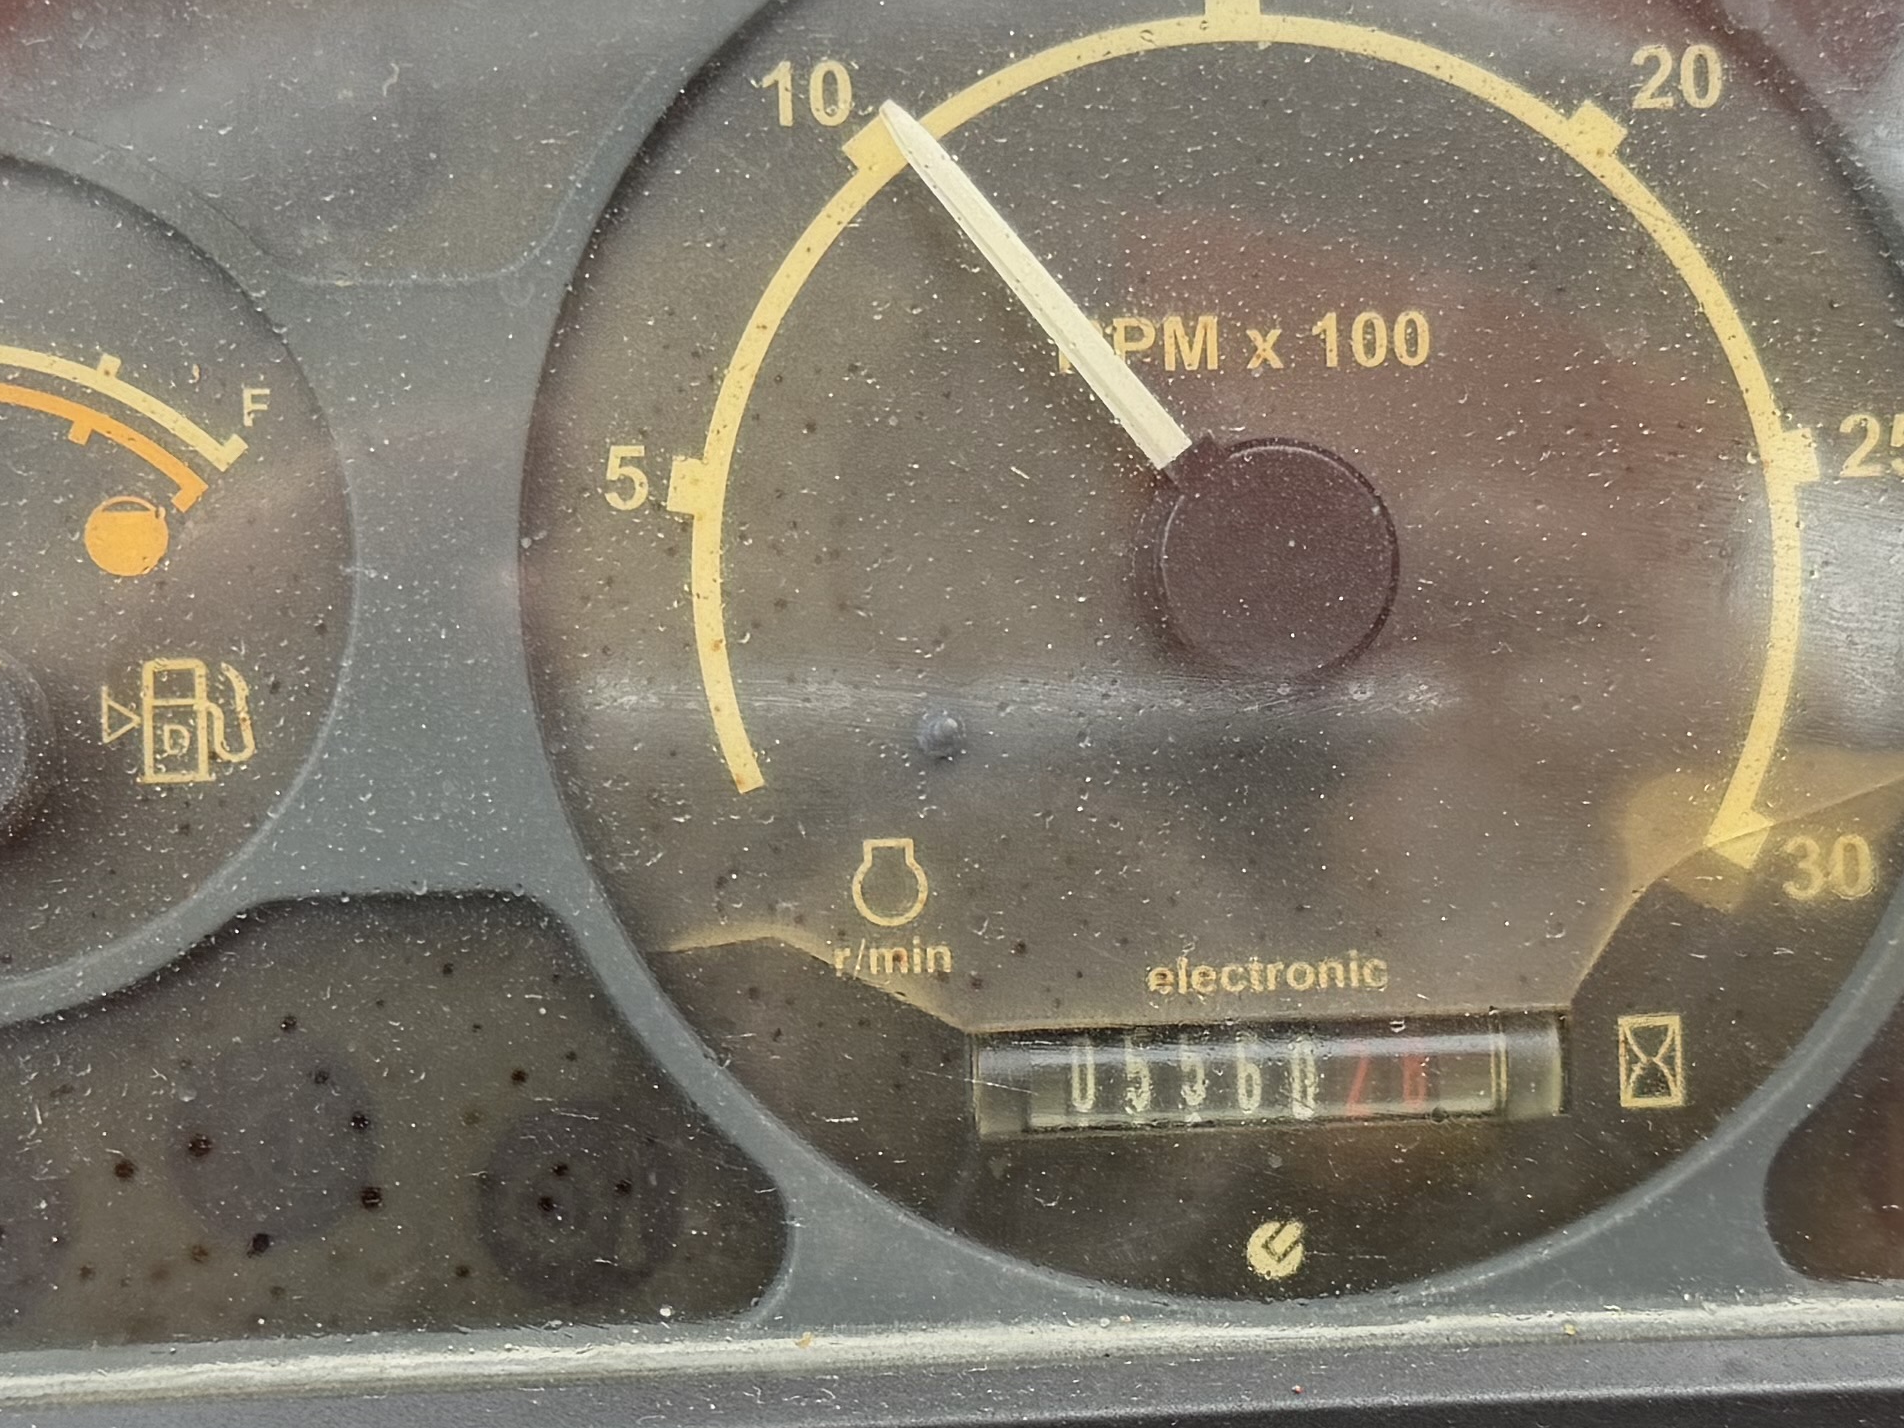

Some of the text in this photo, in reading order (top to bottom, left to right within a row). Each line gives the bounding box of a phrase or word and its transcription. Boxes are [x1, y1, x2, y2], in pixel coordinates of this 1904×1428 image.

[761, 59, 853, 127] 10
[1630, 44, 1724, 110] 20
[1246, 328, 1284, 369] x
[1312, 311, 1431, 369] 100
[241, 386, 271, 427] F
[604, 444, 649, 512] 5
[1782, 834, 1876, 902] 30
[832, 935, 953, 979] r/min
[1145, 949, 1390, 997] electronic
